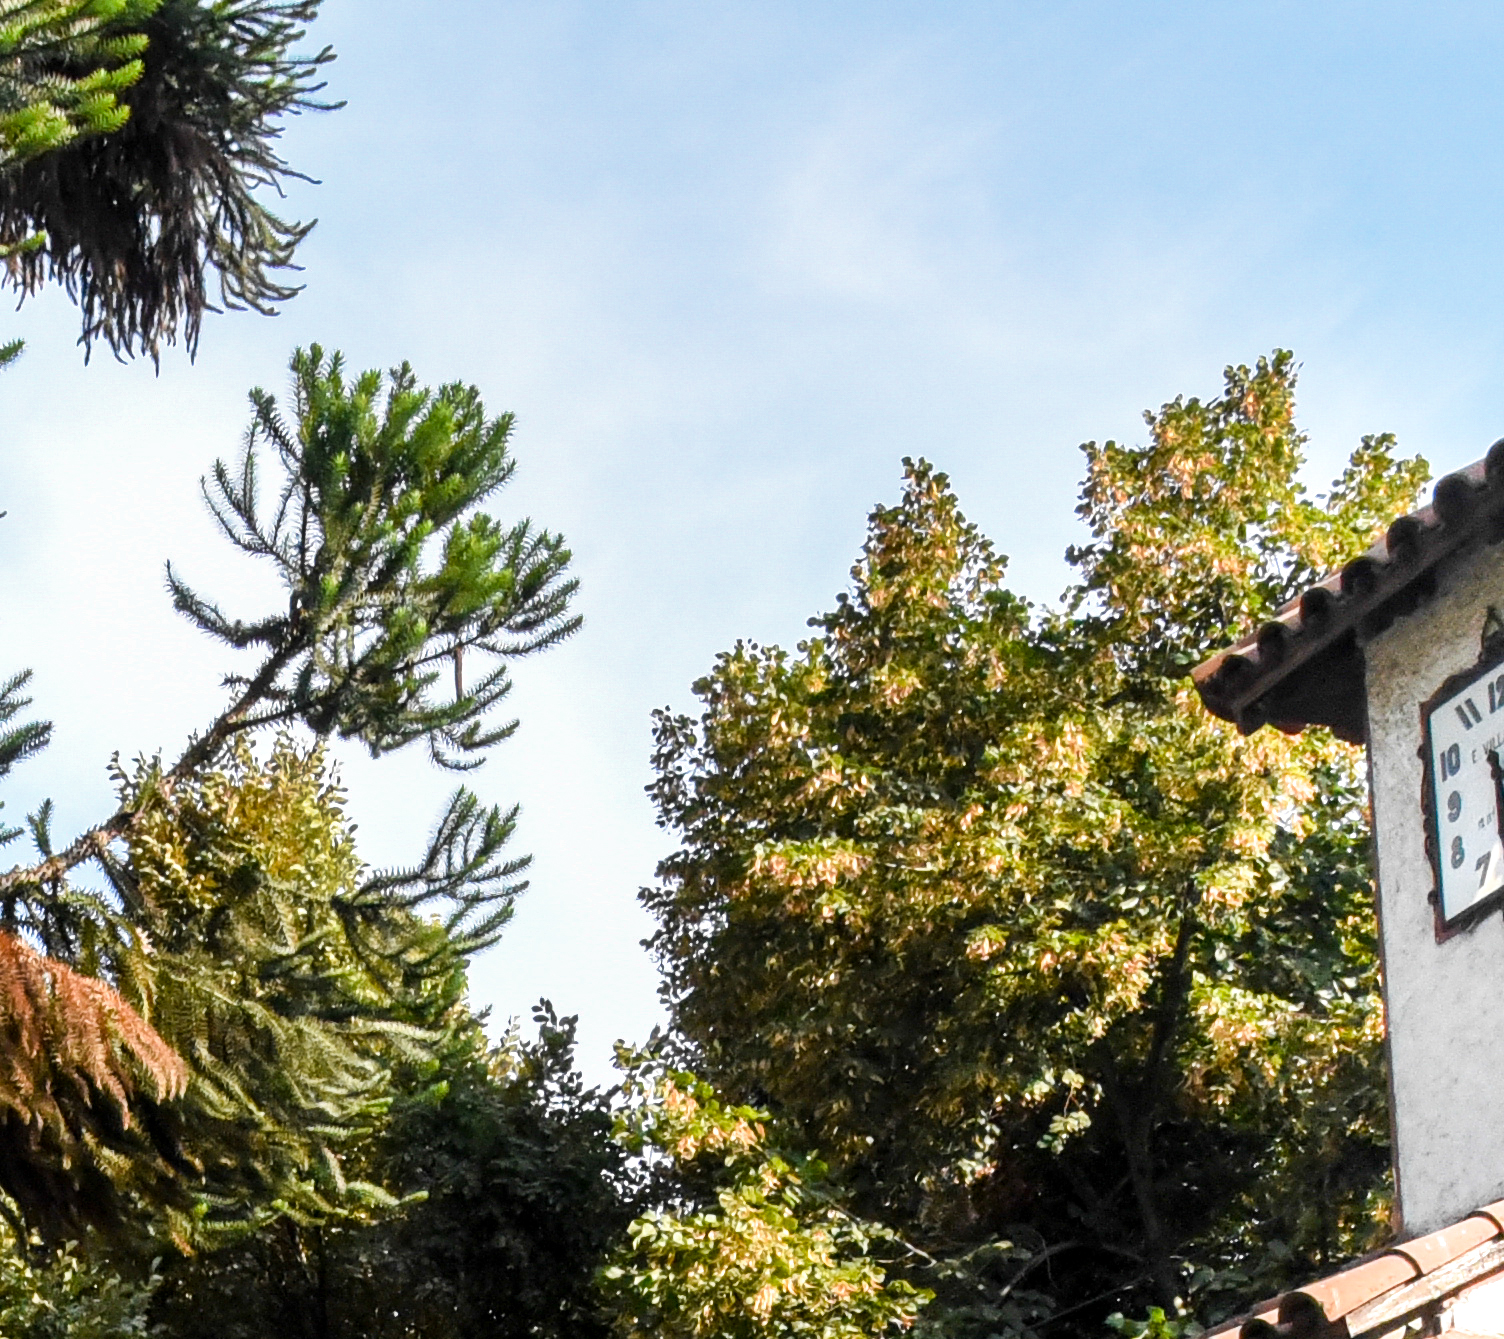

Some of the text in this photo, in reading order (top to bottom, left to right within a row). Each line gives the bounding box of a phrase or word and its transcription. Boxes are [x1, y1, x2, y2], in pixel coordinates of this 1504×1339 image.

[1454, 698, 1483, 730] 11
[1439, 742, 1461, 782] 10
[1447, 790, 1462, 823] 9
[1450, 836, 1466, 869] 8
[1475, 851, 1492, 889] 7
